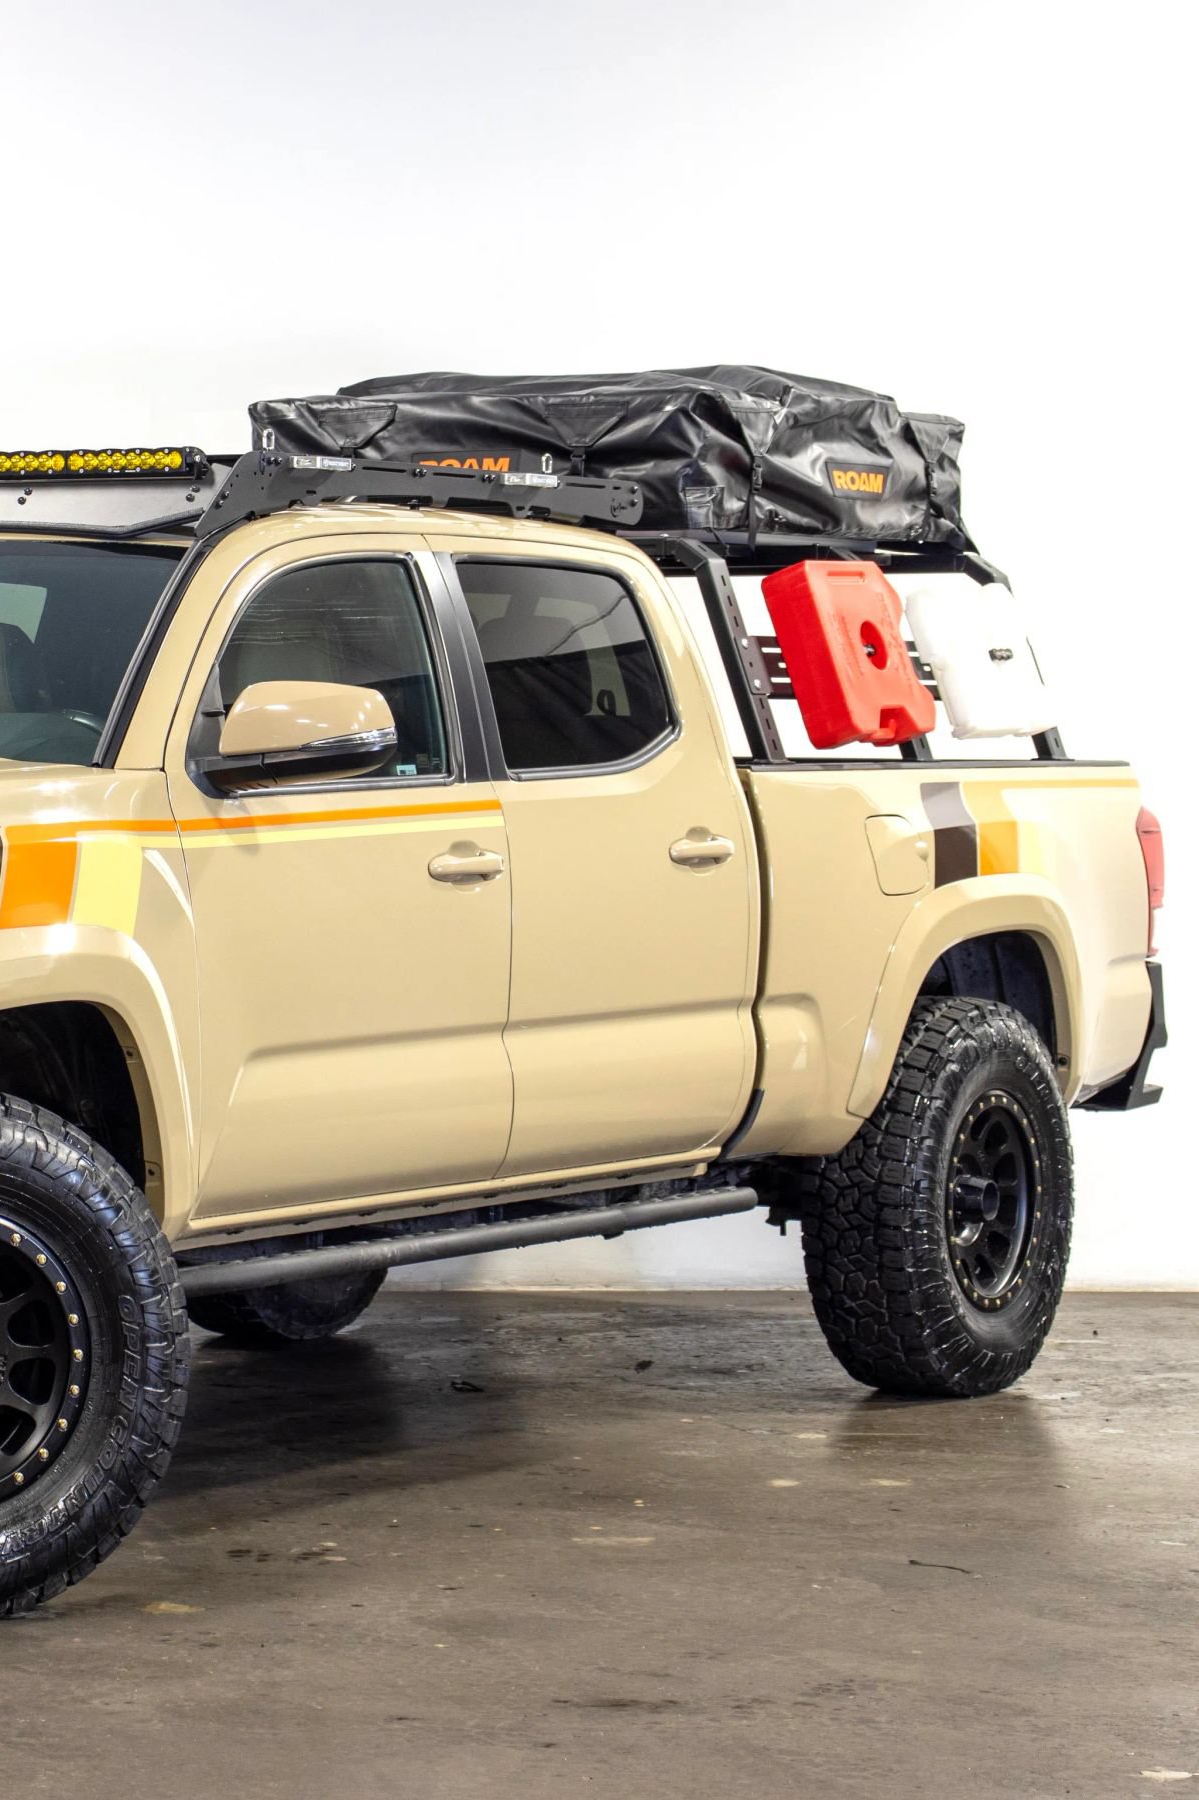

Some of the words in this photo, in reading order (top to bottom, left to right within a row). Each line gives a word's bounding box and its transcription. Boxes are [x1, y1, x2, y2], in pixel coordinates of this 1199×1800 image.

[832, 470, 884, 494] ROAM
[117, 1294, 143, 1410] OPEN
[1, 1414, 129, 1554] COUNTRY
